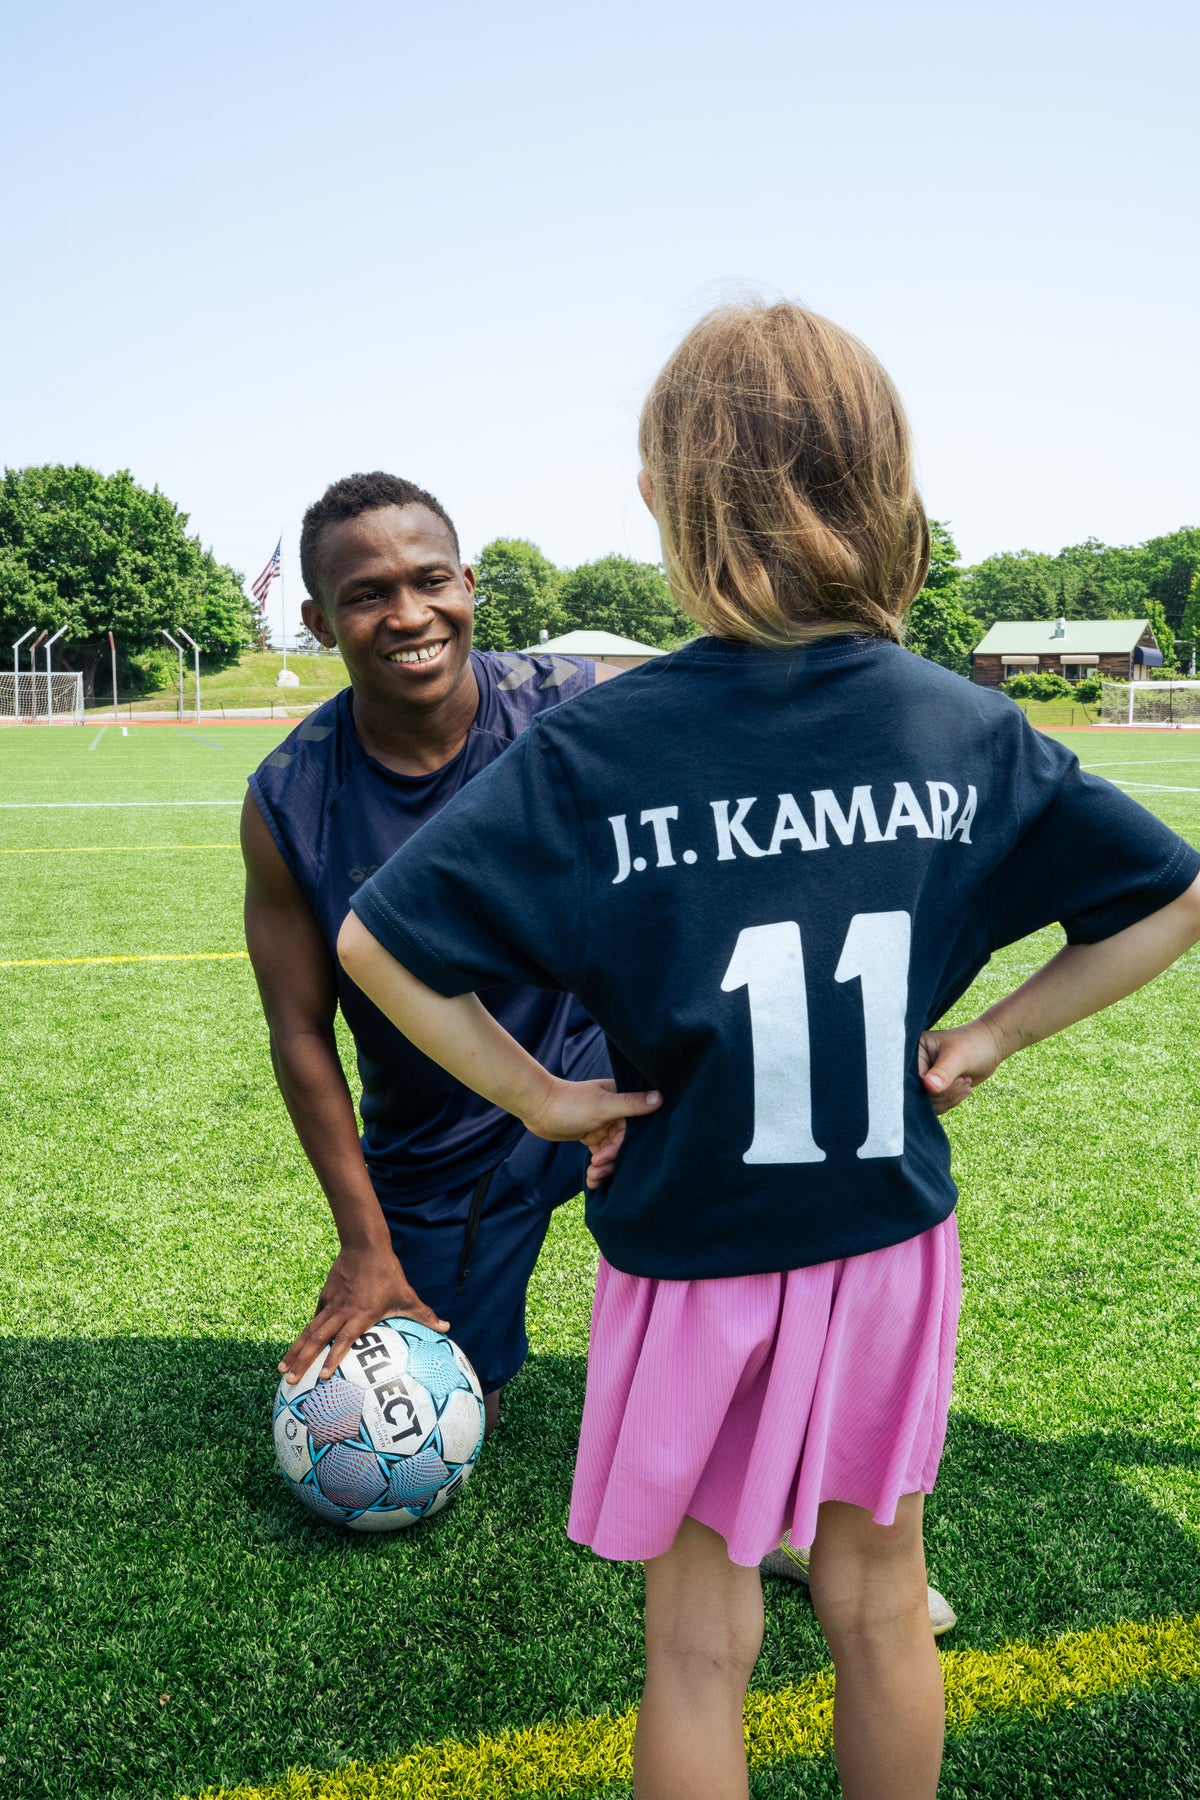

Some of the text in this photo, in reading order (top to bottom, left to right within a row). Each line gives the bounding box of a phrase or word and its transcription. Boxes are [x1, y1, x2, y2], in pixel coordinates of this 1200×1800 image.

[608, 780, 978, 885] J.T. KAMARA
[720, 910, 912, 1165] 11
[350, 1331, 423, 1442] SELECT
[373, 1406, 391, 1445] BRILLANT
